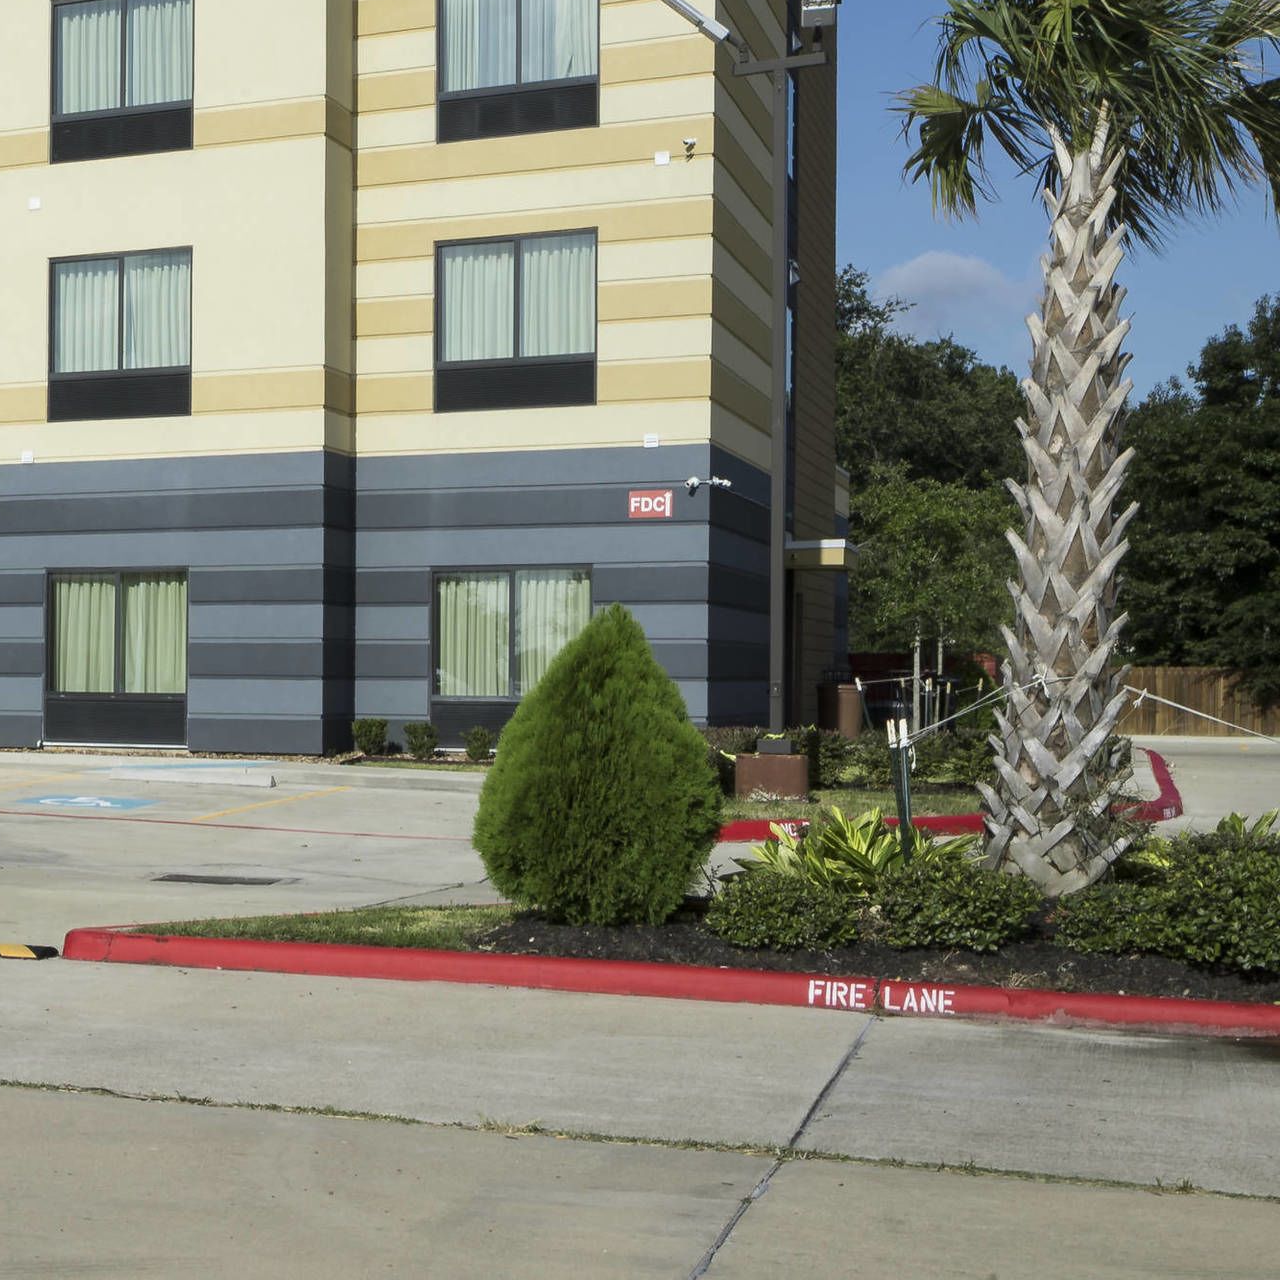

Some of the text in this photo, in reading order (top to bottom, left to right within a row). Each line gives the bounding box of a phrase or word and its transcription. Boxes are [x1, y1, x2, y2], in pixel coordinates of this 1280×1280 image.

[630, 496, 665, 513] FDC
[808, 979, 955, 1015] FIRE LANE
